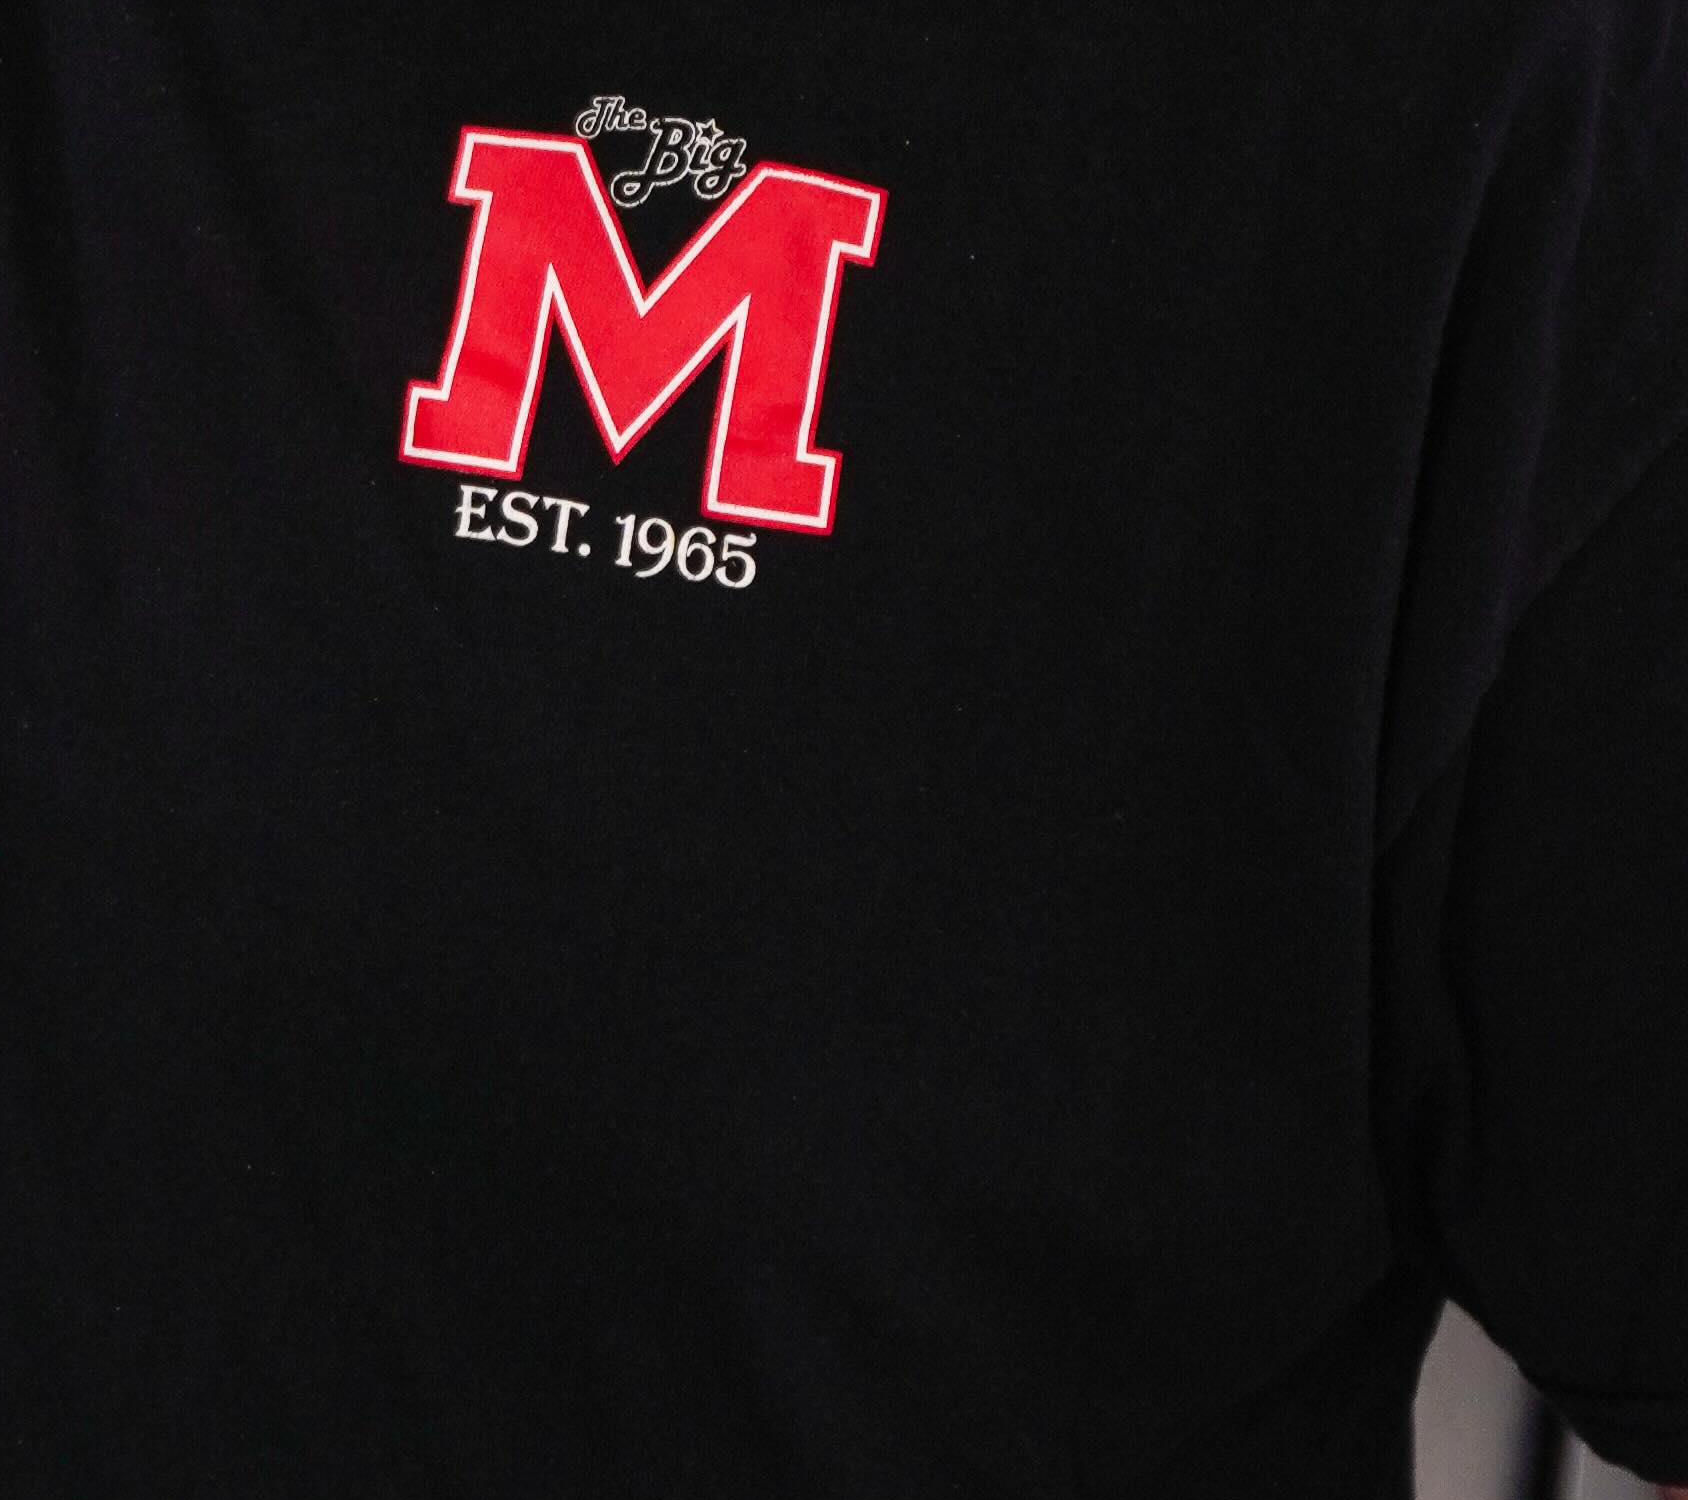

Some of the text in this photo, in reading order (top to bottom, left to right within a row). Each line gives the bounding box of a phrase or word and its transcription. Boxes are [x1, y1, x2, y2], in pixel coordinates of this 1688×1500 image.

[575, 96, 748, 207] The Big
[398, 125, 888, 537] M
[454, 484, 758, 589] EST. 1965
